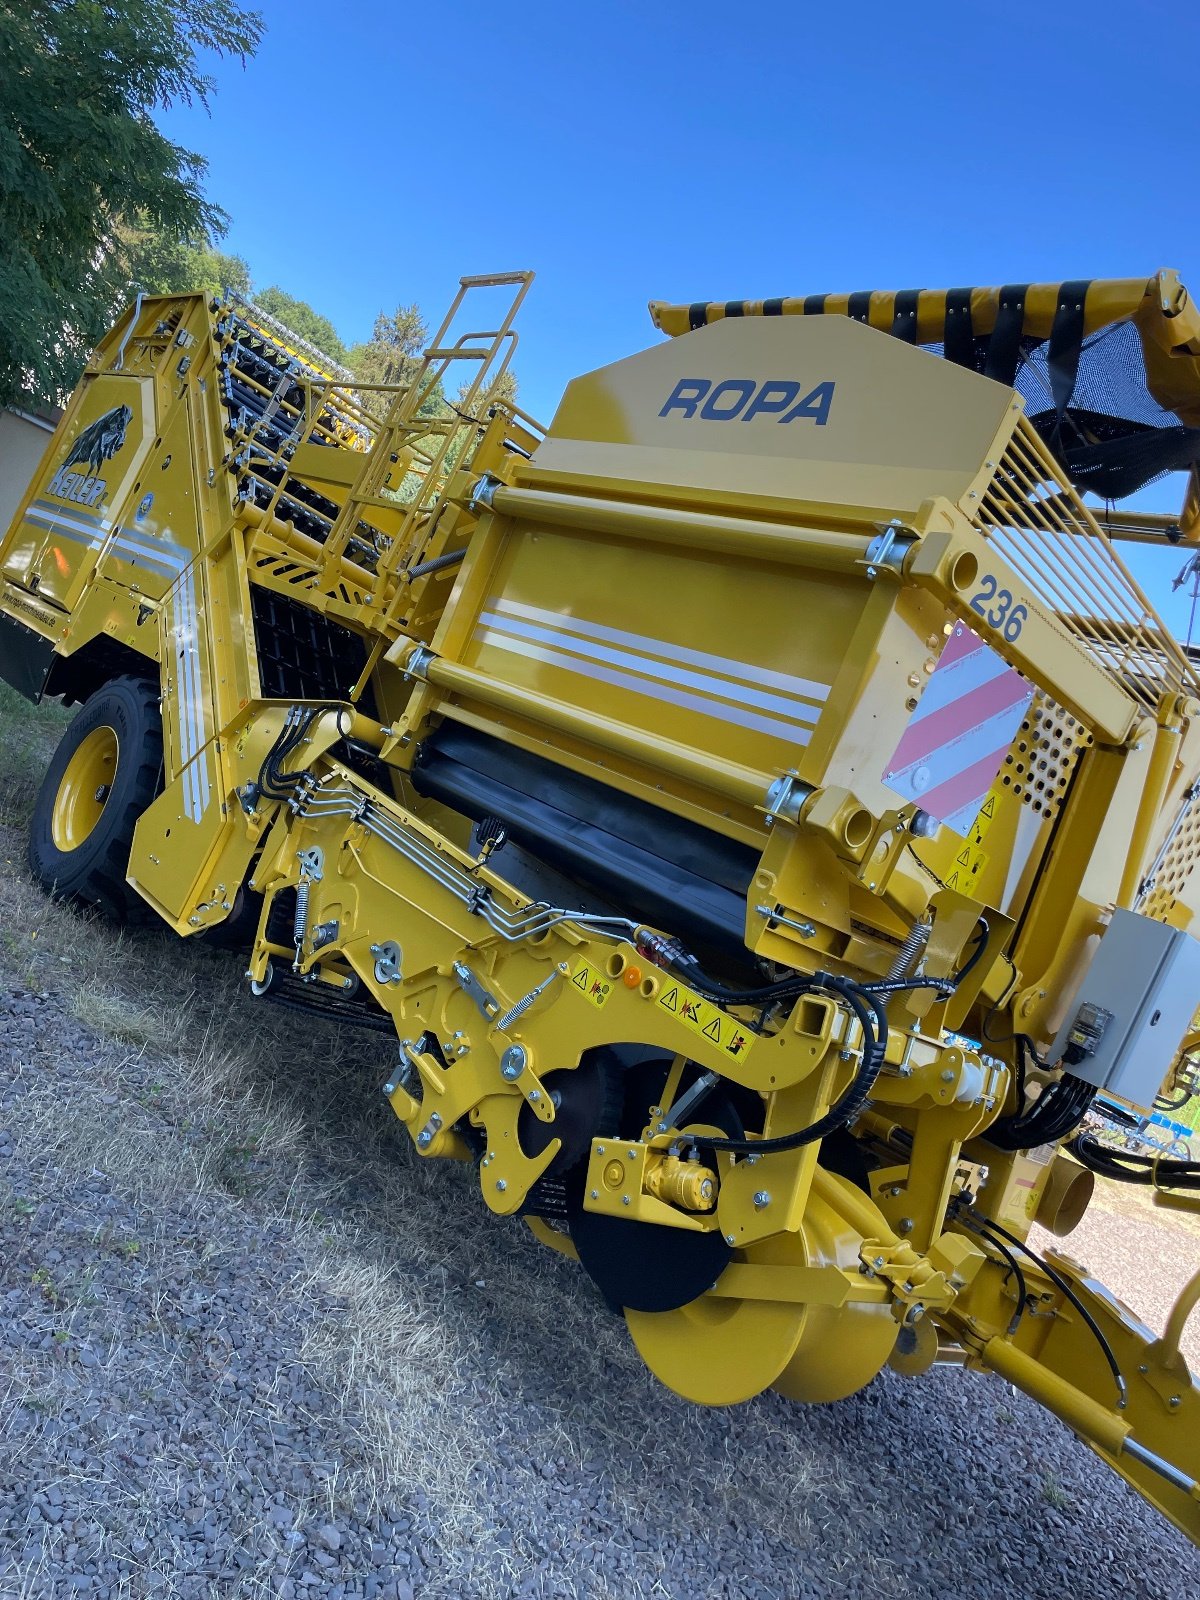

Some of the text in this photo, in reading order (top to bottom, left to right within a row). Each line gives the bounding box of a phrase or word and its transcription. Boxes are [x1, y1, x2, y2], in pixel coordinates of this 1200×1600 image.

[658, 379, 836, 425] ROPA
[44, 464, 107, 507] KEILER
[969, 574, 1028, 643] 236
